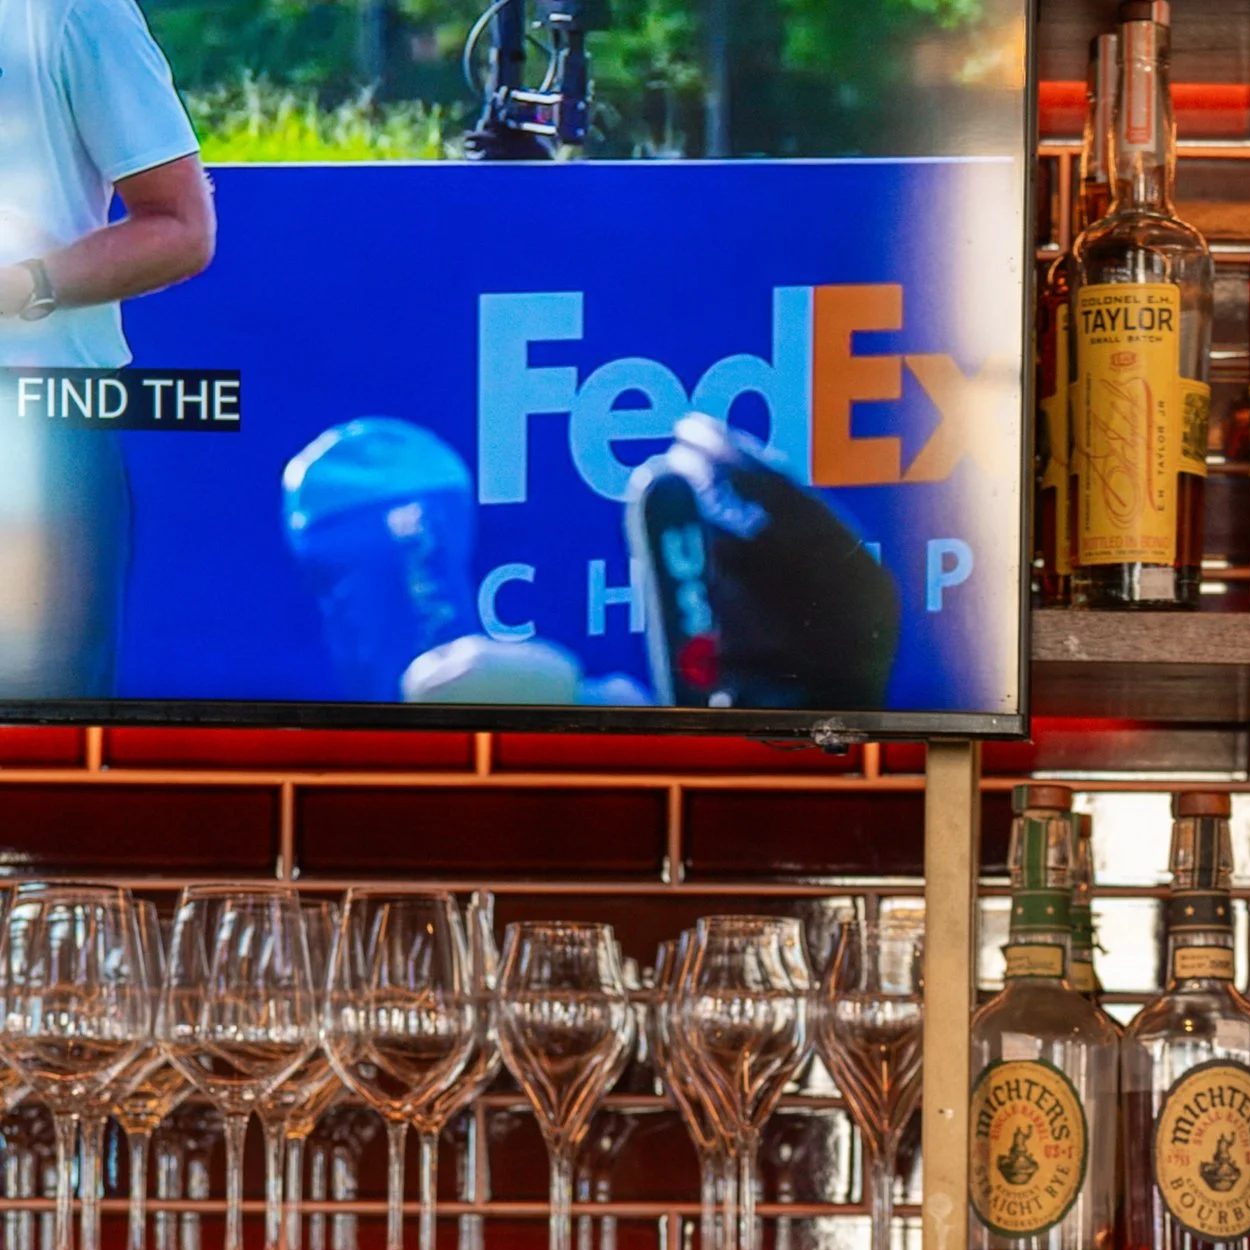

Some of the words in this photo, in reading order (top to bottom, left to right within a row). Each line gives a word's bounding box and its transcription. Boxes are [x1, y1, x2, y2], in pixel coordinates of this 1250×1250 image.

[1081, 296, 1140, 307] COLONEL
[1081, 307, 1173, 334] TAYLOR
[17, 377, 128, 419] FIND
[142, 379, 241, 421] THE
[478, 283, 1002, 504] FedEx
[1157, 425, 1166, 477] TAYLOR
[976, 1078, 1070, 1141] MICHTER'S
[1044, 1163, 1070, 1198] RYE
